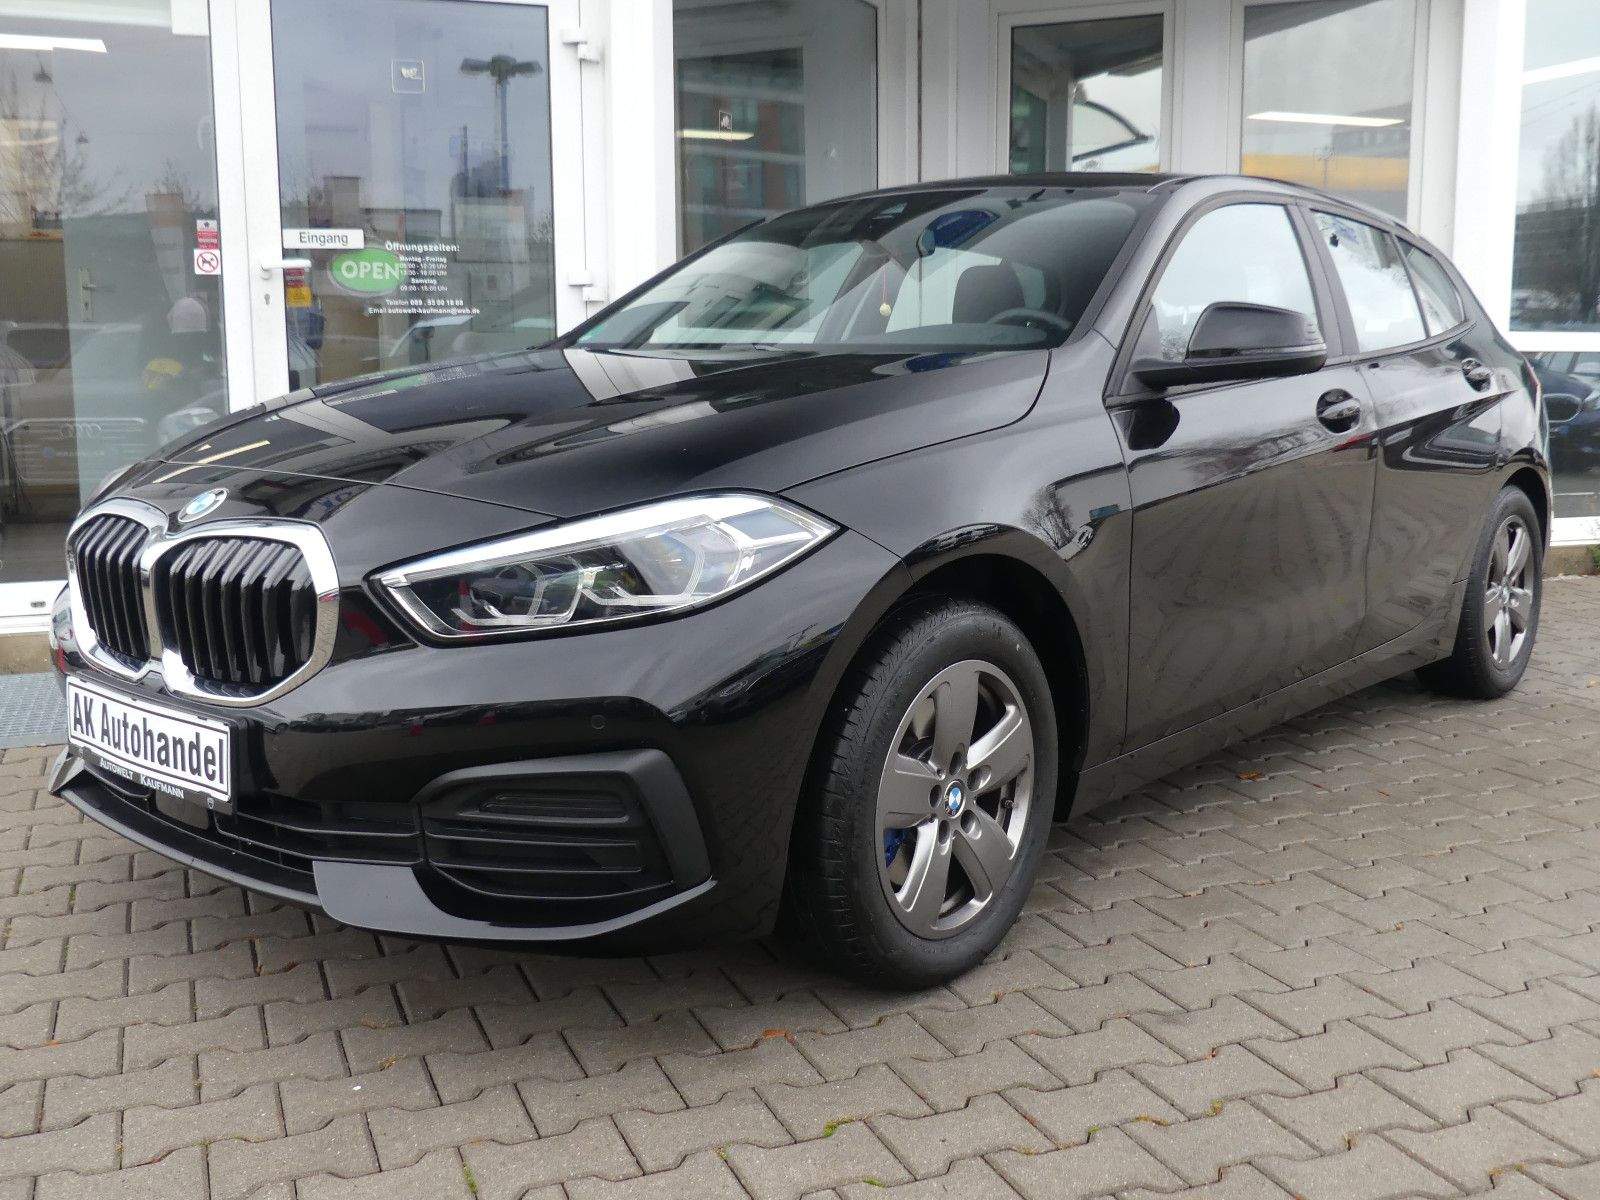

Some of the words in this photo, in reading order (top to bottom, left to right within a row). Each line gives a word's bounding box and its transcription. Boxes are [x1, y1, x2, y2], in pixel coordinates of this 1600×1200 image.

[299, 231, 348, 246] Eingang
[385, 241, 460, 253] Öffnungszeiten:
[341, 261, 400, 279] OPEN
[73, 692, 96, 739] AK
[100, 702, 225, 785] Autohandel
[140, 773, 185, 800] KAUFMANN
